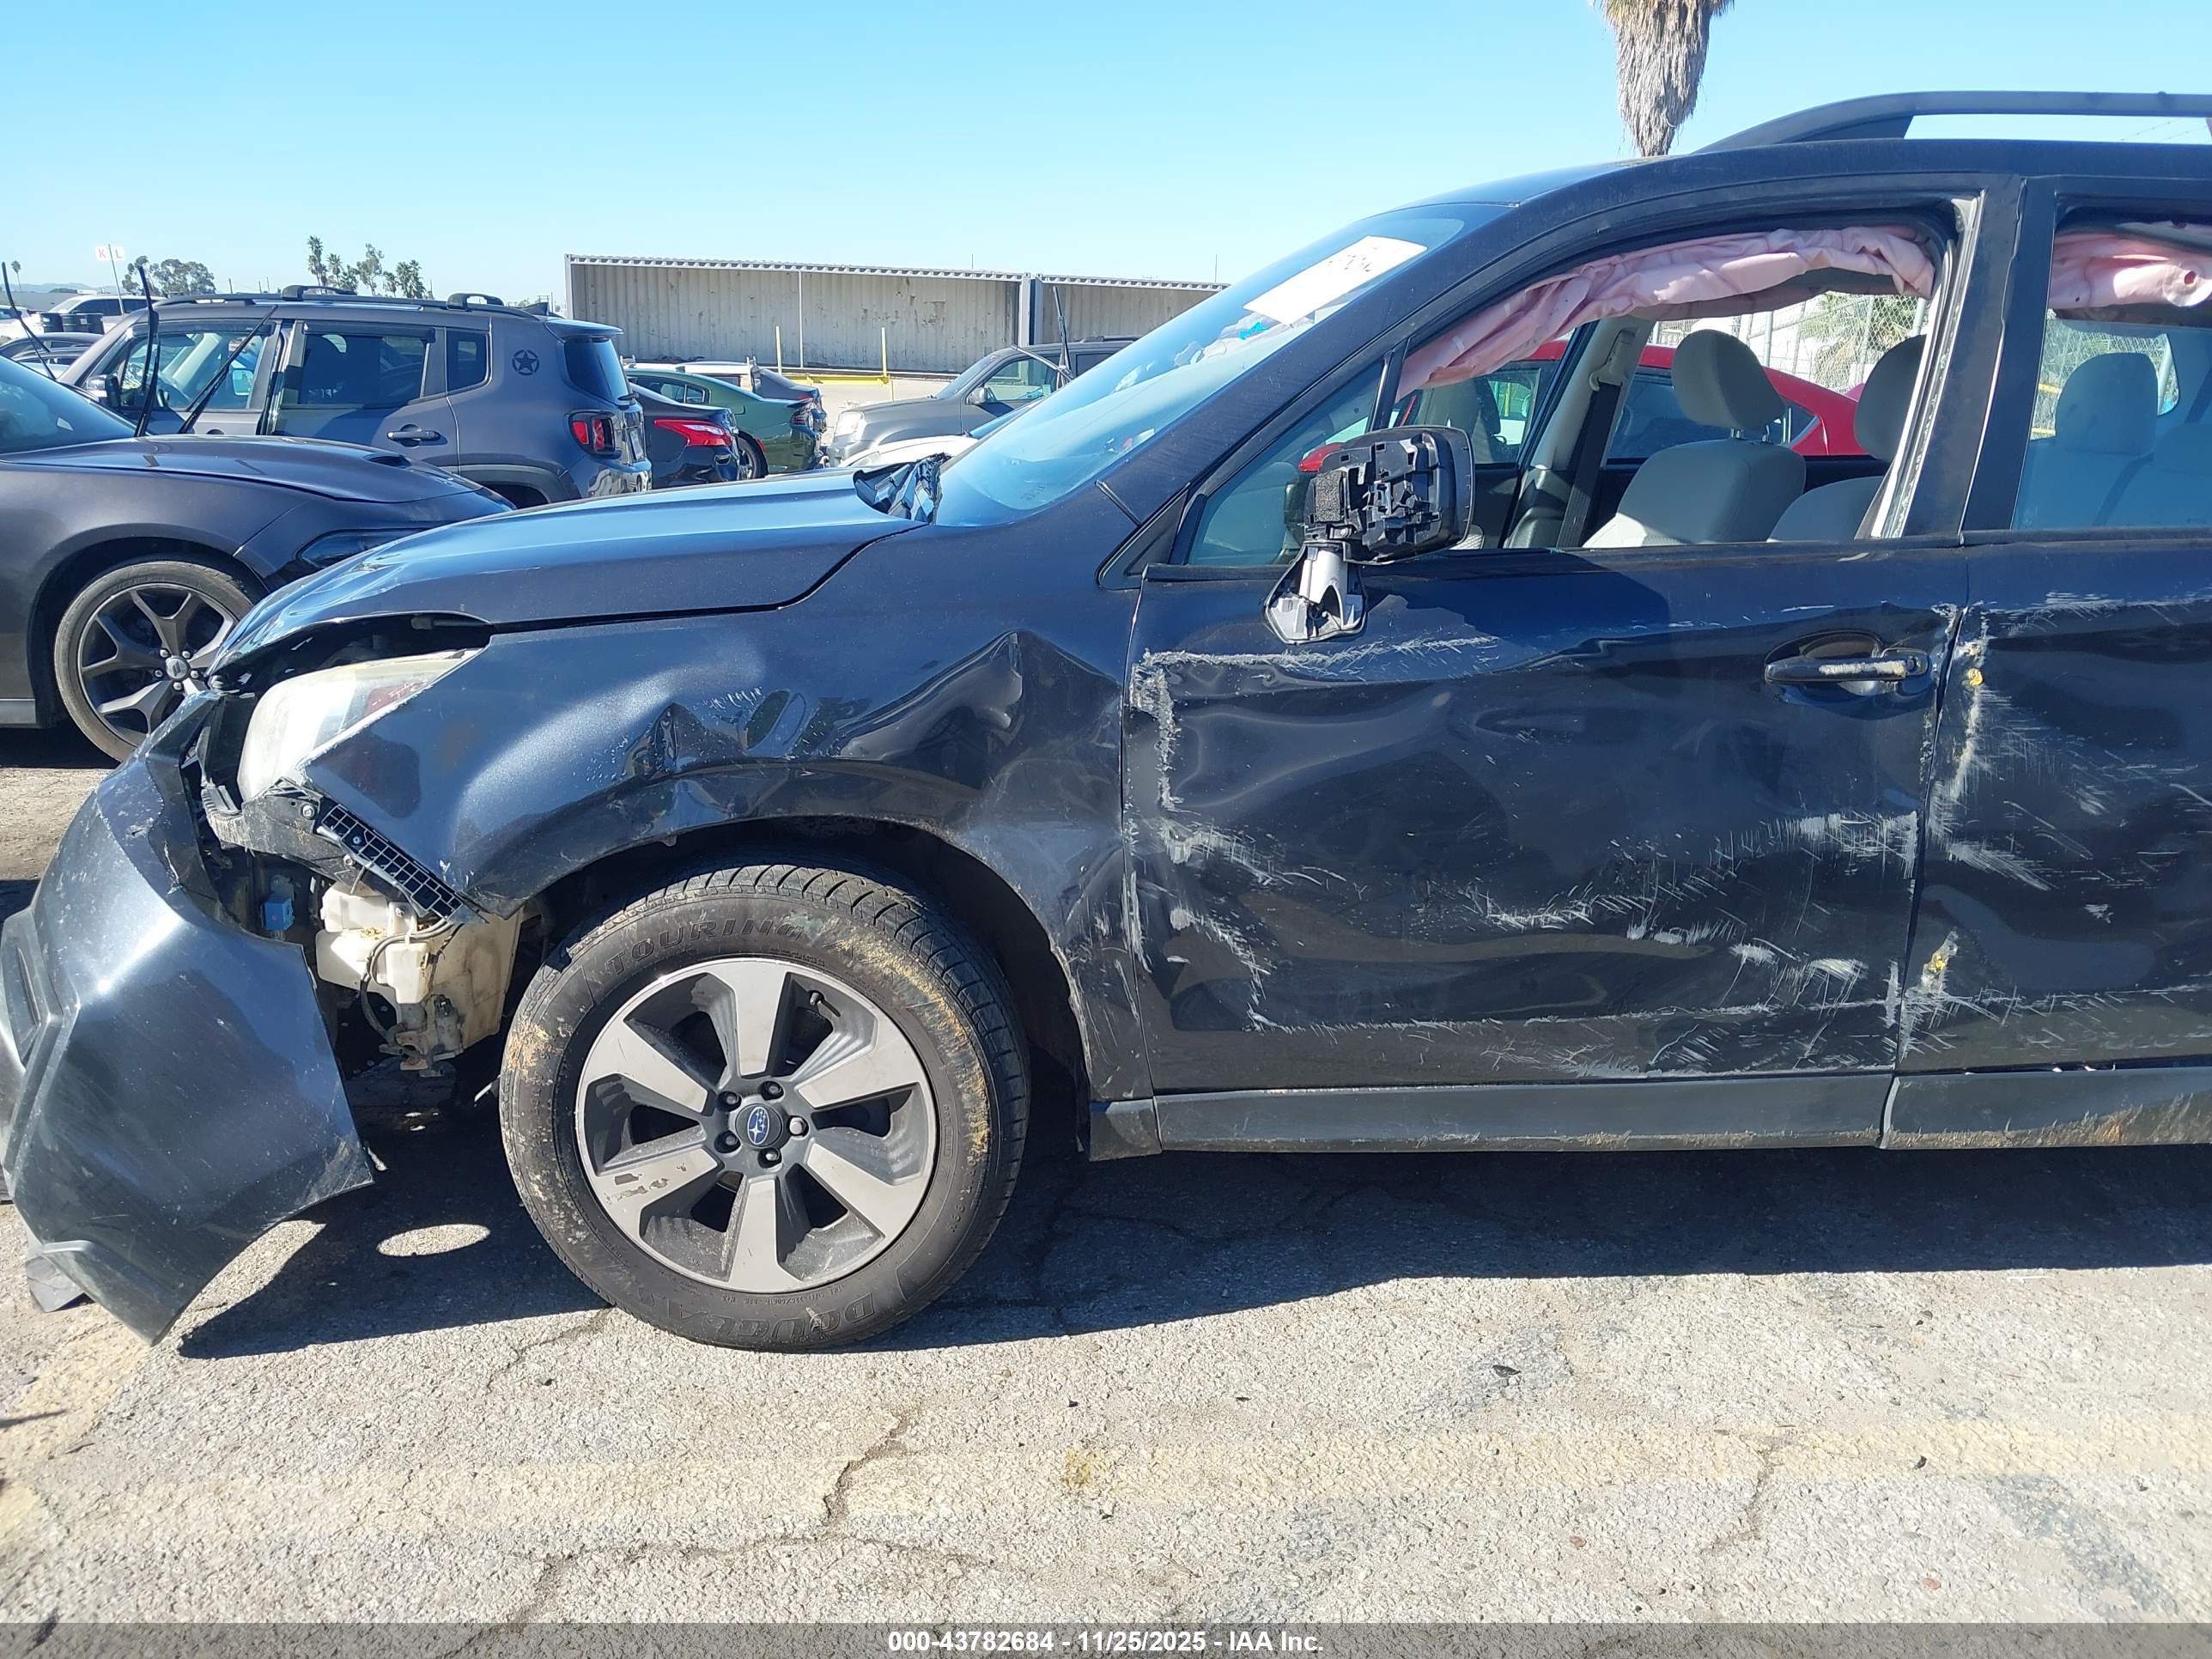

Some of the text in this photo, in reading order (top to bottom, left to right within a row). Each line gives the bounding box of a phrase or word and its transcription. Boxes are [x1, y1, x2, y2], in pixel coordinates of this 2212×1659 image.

[98, 248, 106, 258] K
[115, 248, 124, 258] L
[604, 917, 805, 976] TOURING
